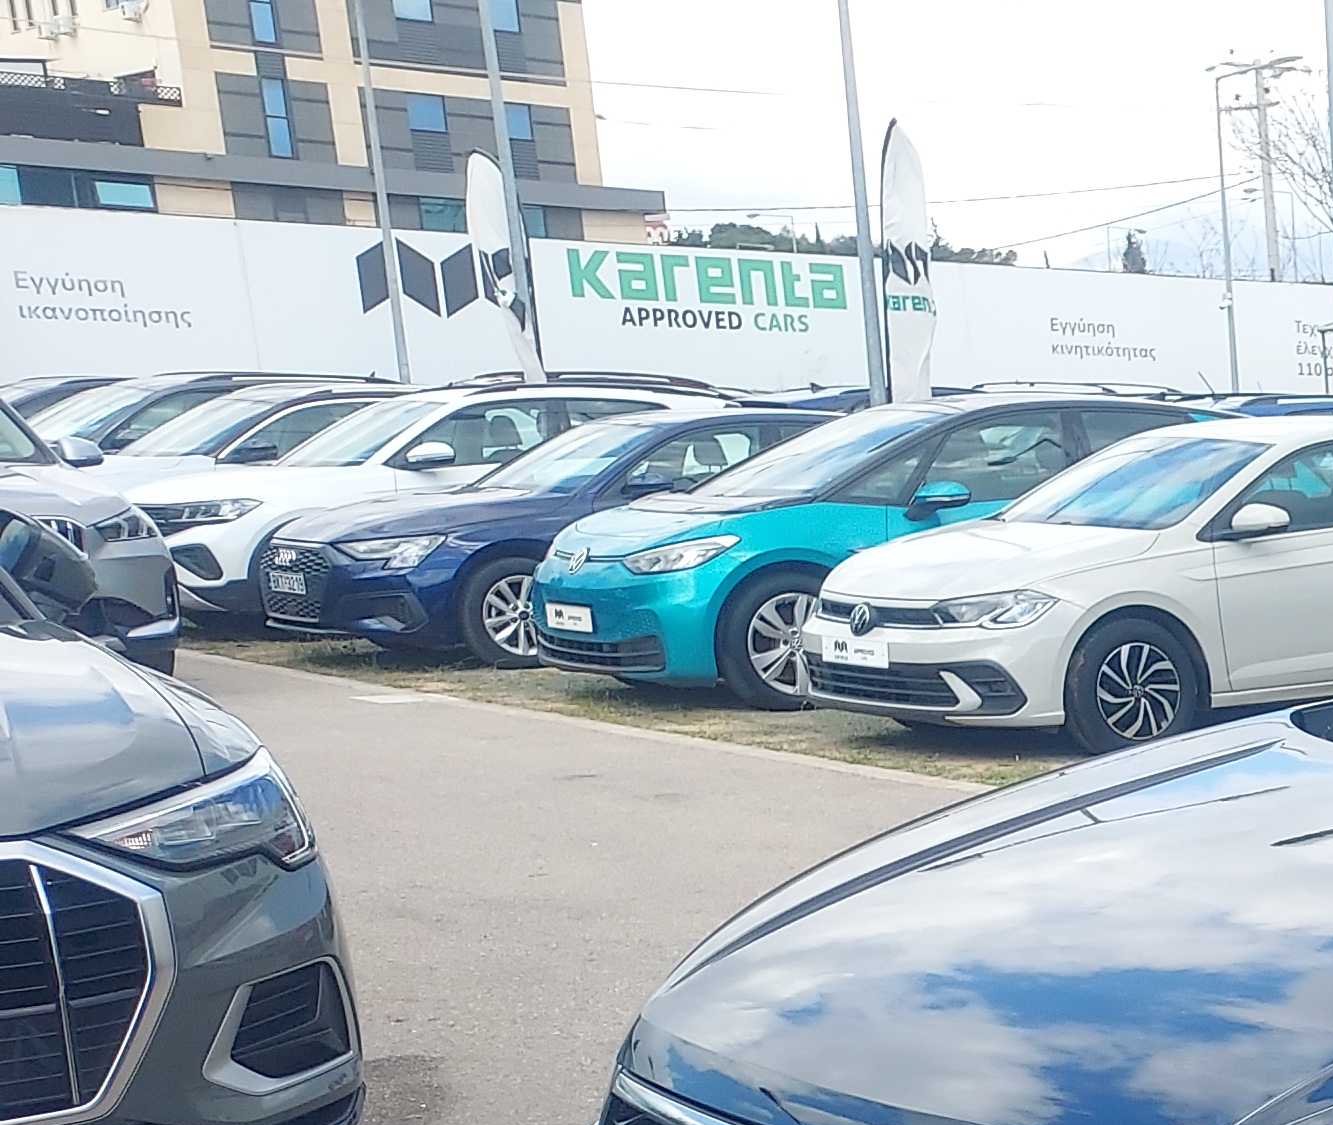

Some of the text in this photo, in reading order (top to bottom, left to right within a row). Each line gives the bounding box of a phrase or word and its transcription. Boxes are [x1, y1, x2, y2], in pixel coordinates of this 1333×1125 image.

[13, 270, 126, 299] Εγγύηση
[18, 303, 193, 329] ικανοποίησης
[621, 306, 810, 333] APPROVED CARS
[1050, 316, 1116, 338] Εγγύηση
[1051, 340, 1157, 362] κινητικότητας
[1297, 362, 1323, 377] 110
